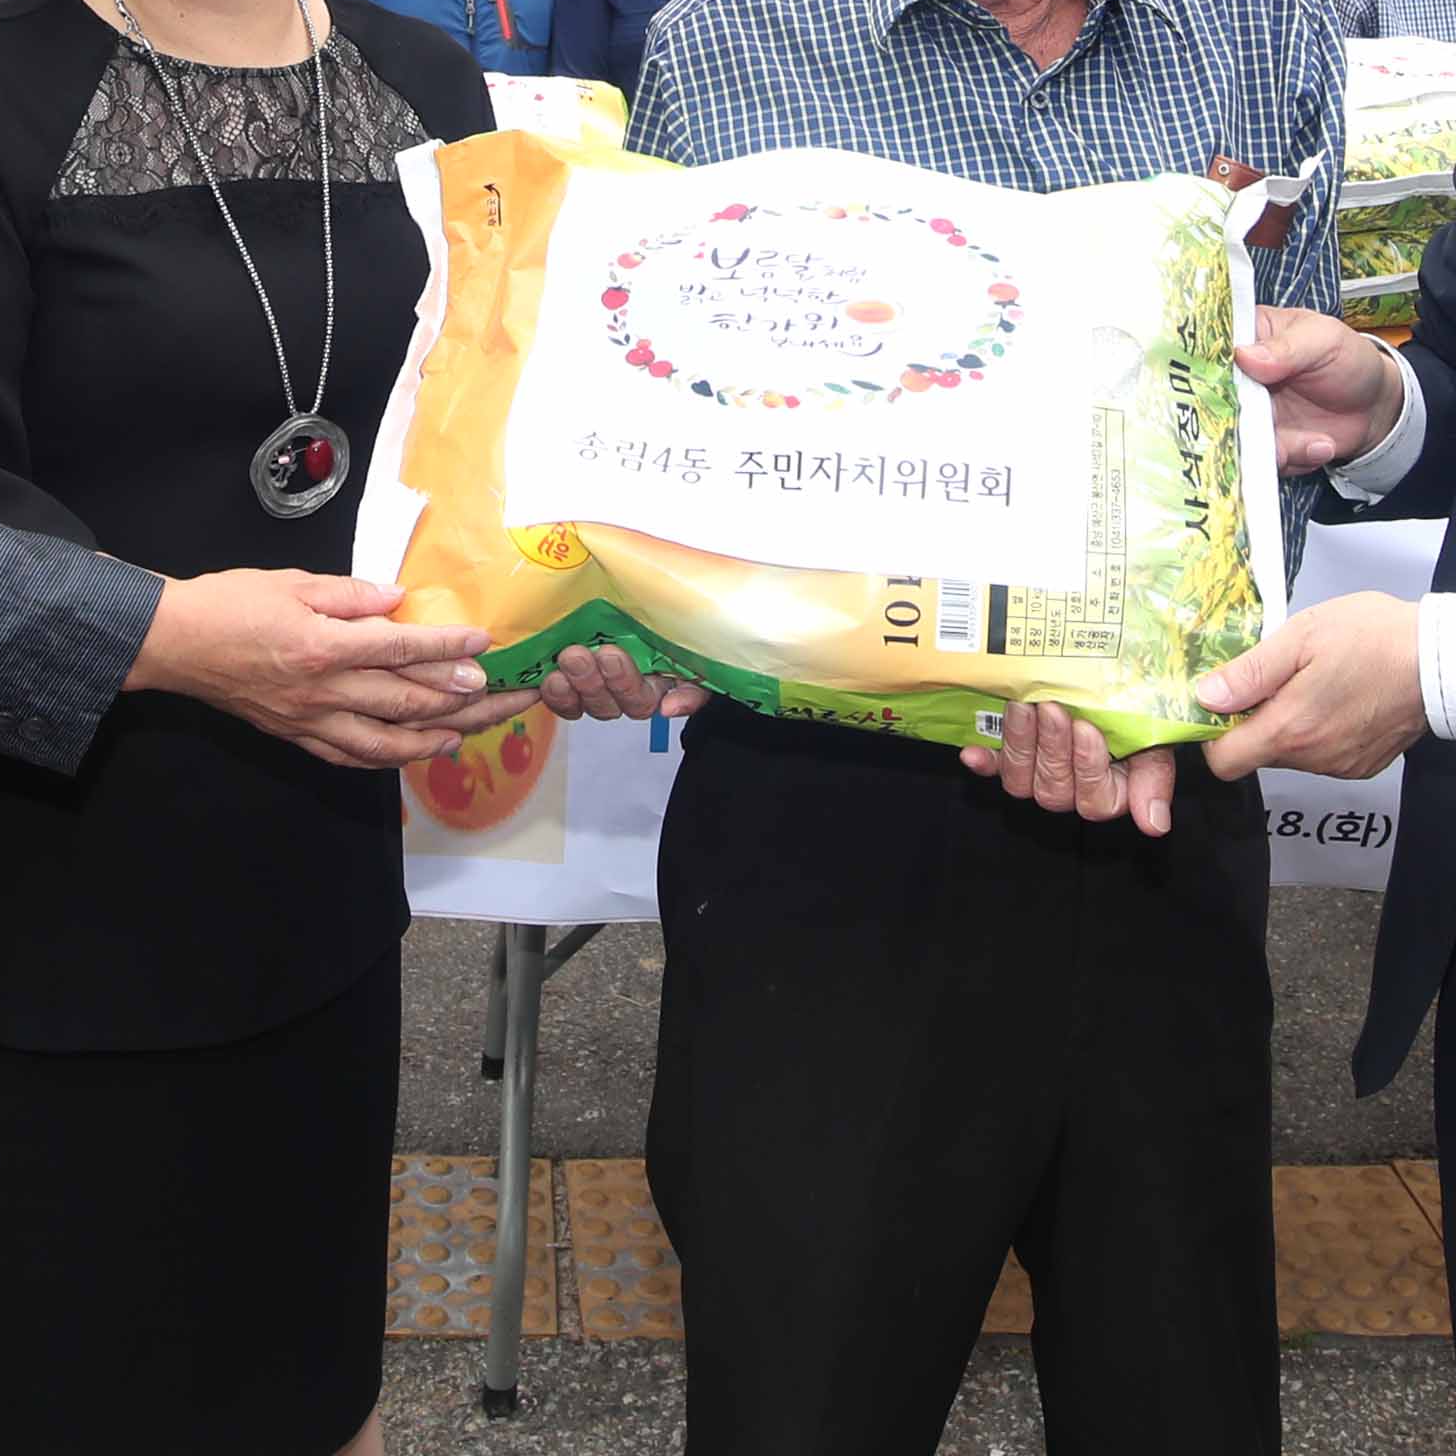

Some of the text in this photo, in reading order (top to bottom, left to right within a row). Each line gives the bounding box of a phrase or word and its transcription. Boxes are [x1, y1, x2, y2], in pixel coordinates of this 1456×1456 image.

[708, 311, 839, 334] 한가위
[1168, 316, 1211, 542] 사석정미소
[573, 431, 1013, 507] 송림4동 주민자치위원회
[883, 600, 922, 648] 10
